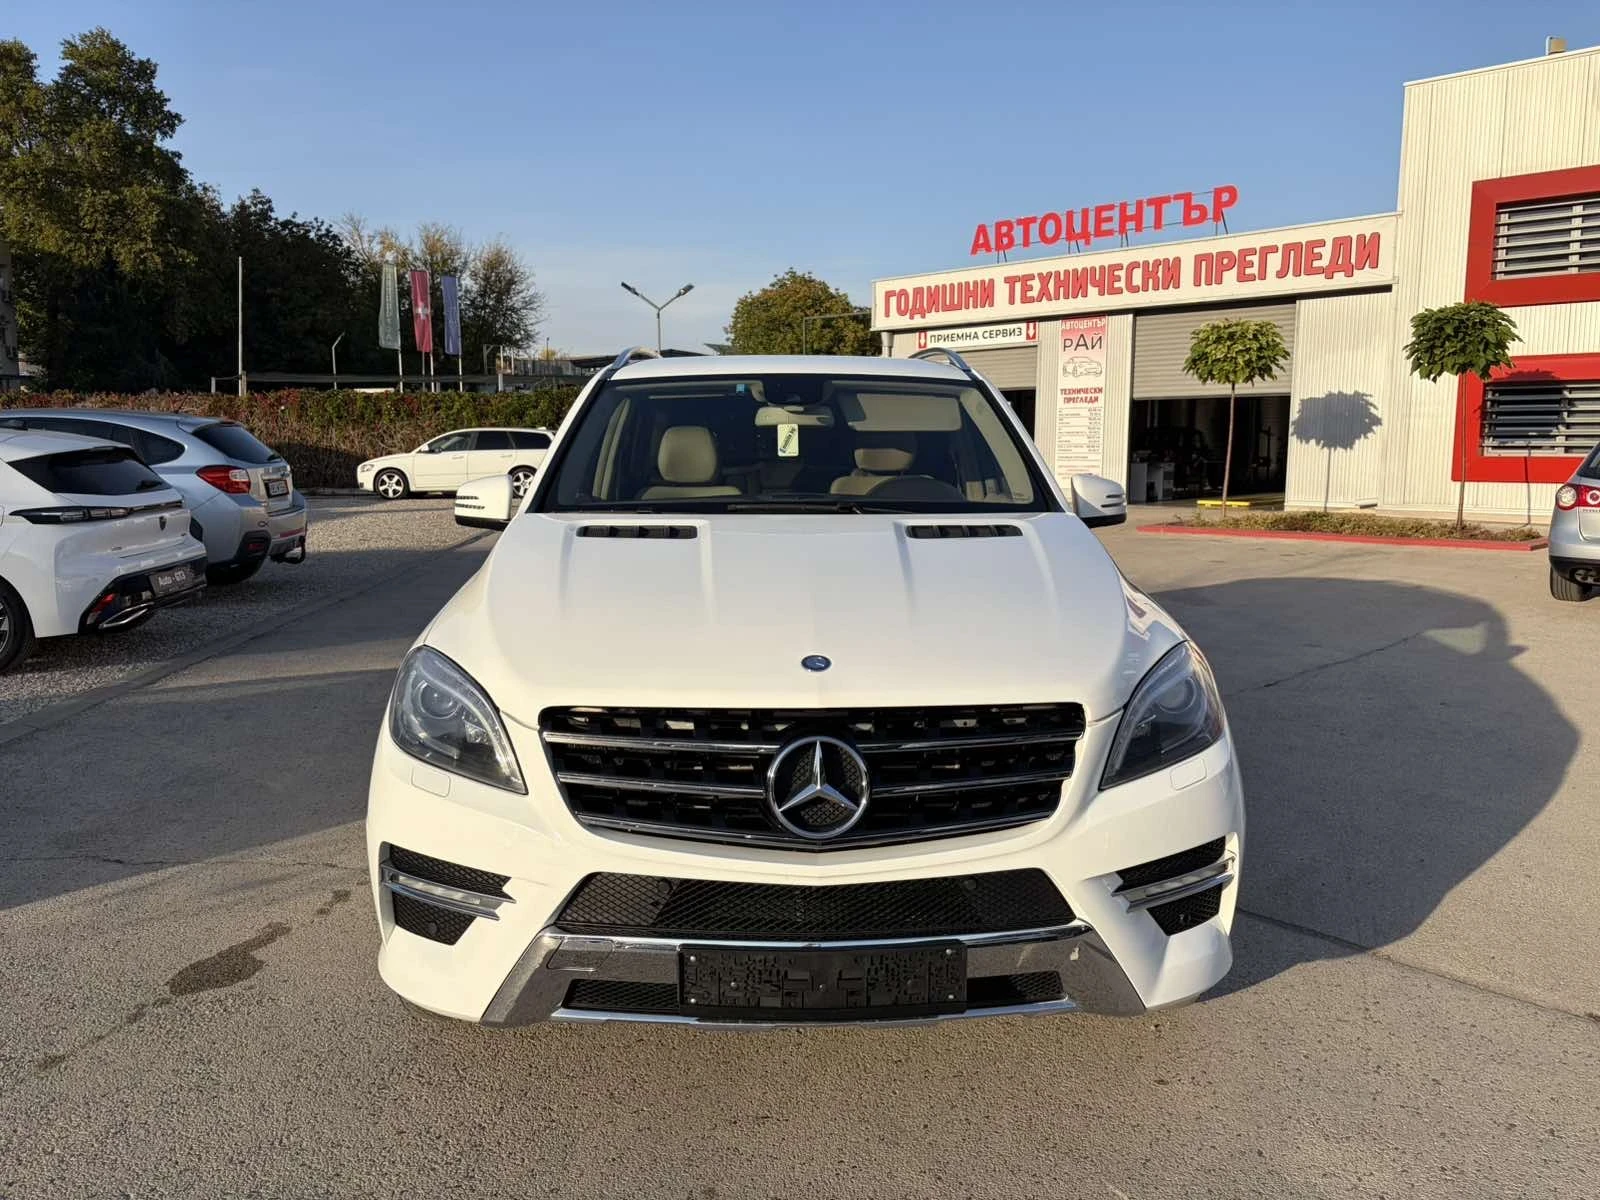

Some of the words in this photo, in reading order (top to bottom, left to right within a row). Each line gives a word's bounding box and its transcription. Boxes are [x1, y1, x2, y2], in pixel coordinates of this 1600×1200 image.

[970, 184, 1239, 256] АВТОЦЕНТЪР
[884, 278, 995, 320] ГОДИШНИ
[1004, 256, 1181, 305] ТЕХНИЧЕСКИ
[1193, 232, 1381, 286] ПРЕГЛЕДИ
[1061, 318, 1106, 330] АВТОЦЕНТЪР
[929, 331, 979, 344] ПРИЕМНА
[982, 327, 1023, 340] СЕРВИЗ
[1063, 333, 1102, 352] РАЙ
[1060, 387, 1103, 396] ТЕХНИЧЕСКИ
[1063, 395, 1099, 405] ПРЕГЛЕДИ
